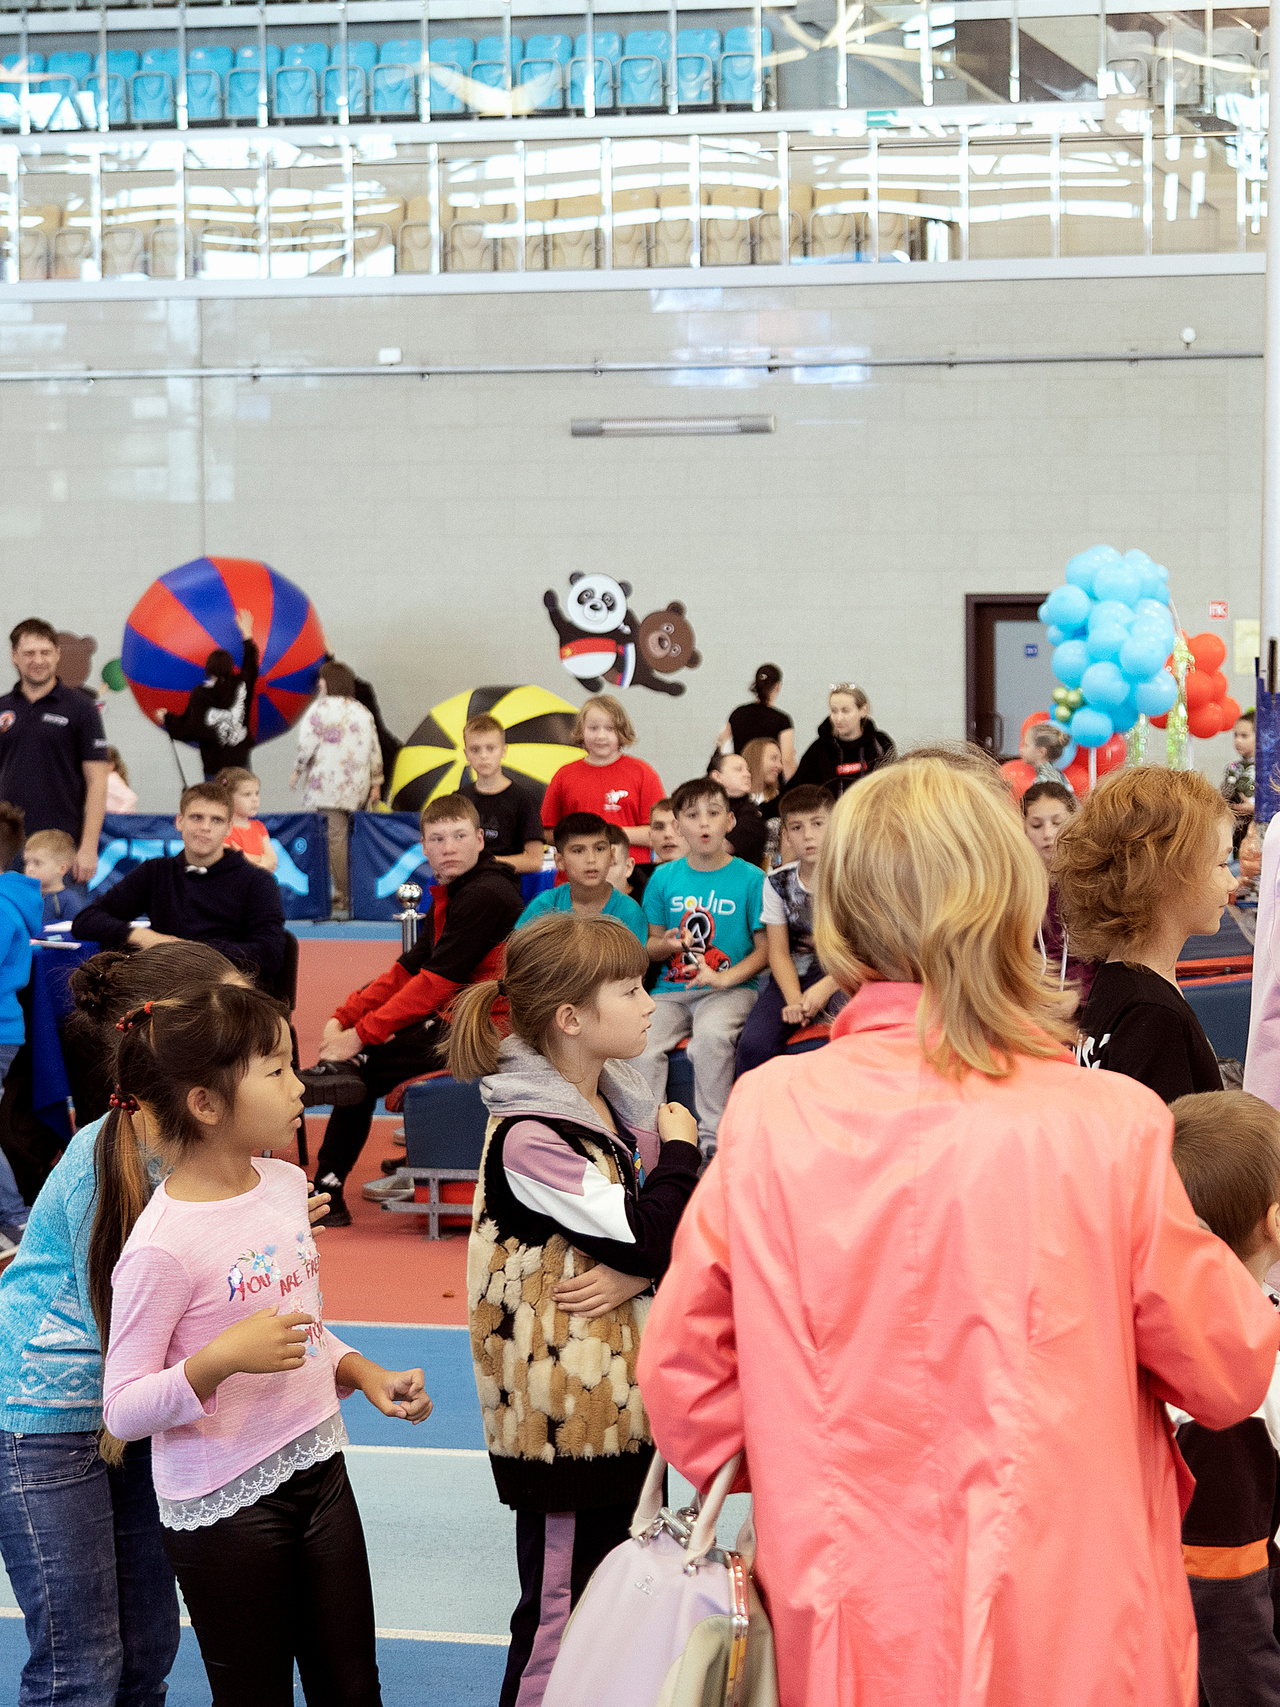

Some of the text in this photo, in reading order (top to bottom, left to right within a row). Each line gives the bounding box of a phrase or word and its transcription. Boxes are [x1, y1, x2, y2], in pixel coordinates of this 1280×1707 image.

[670, 890, 736, 915] SQUID
[236, 1273, 271, 1301] YOU
[280, 1269, 303, 1297] ARE
